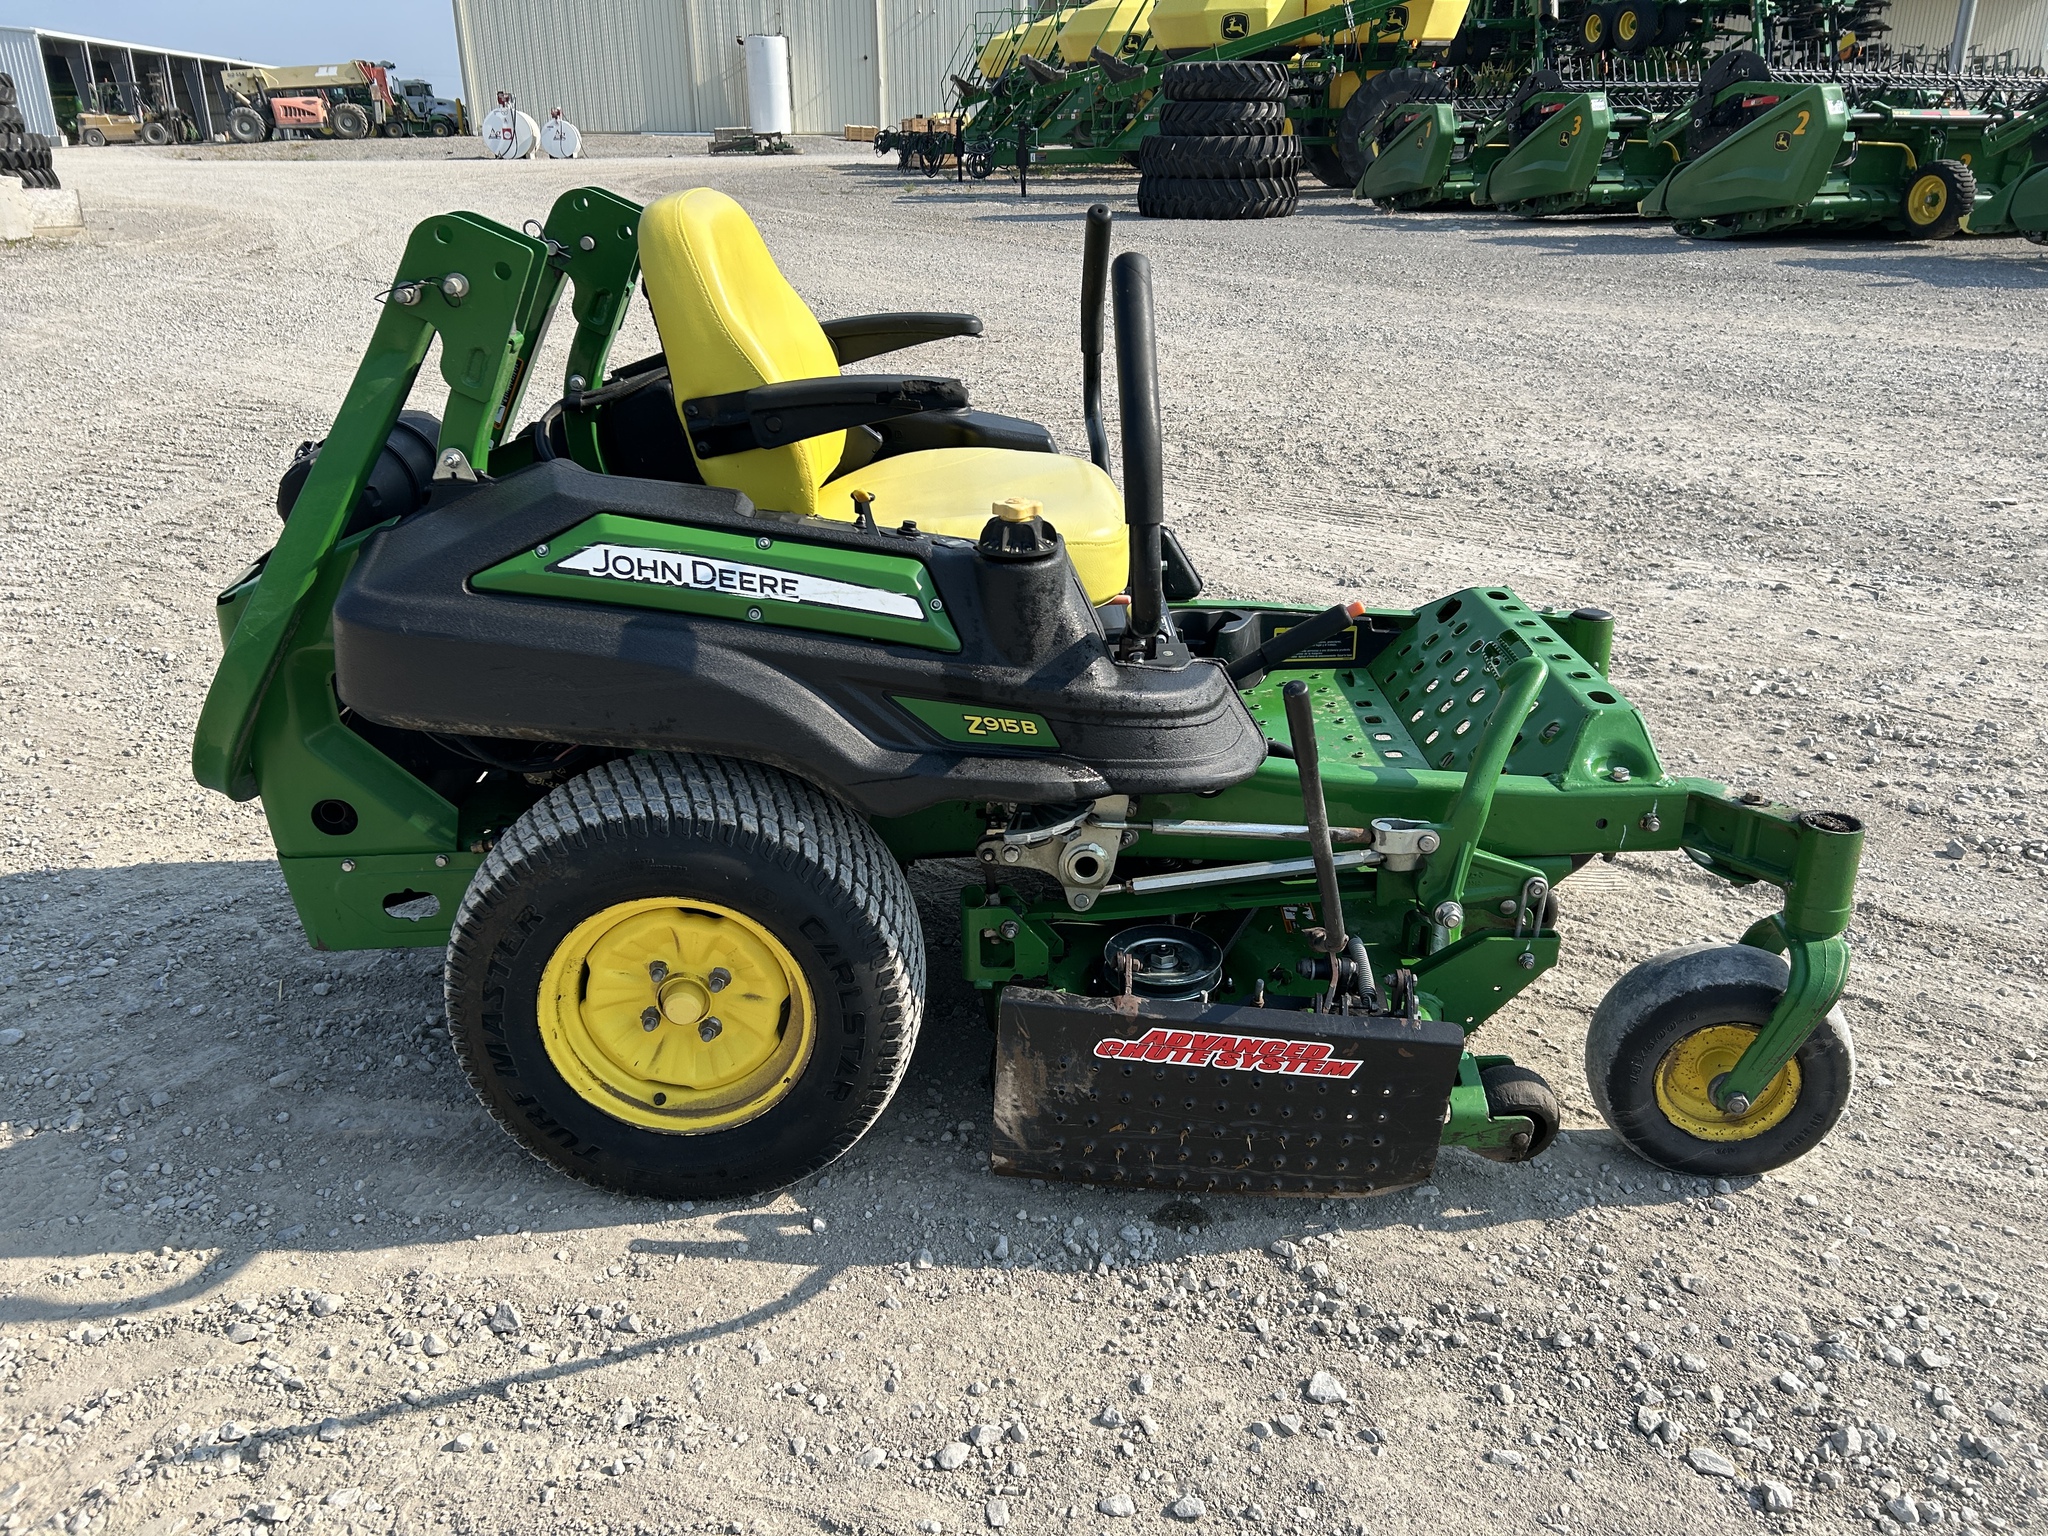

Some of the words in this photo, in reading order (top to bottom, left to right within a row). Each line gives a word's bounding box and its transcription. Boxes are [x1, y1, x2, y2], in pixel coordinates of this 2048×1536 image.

[1425, 121, 1432, 139] 1
[1571, 115, 1582, 136] 3
[1792, 110, 1810, 135] 2
[593, 549, 682, 582] JOHN
[691, 560, 799, 598] DEERE
[962, 714, 1038, 736] Z915B
[481, 904, 545, 1079] MASTER
[799, 914, 866, 1102] CARLSTAR
[1098, 1040, 1212, 1065] CHUTE
[1214, 1051, 1359, 1078] SYSTEM
[1140, 1029, 1332, 1059] ADVANCED
[505, 1088, 603, 1165] TURF
